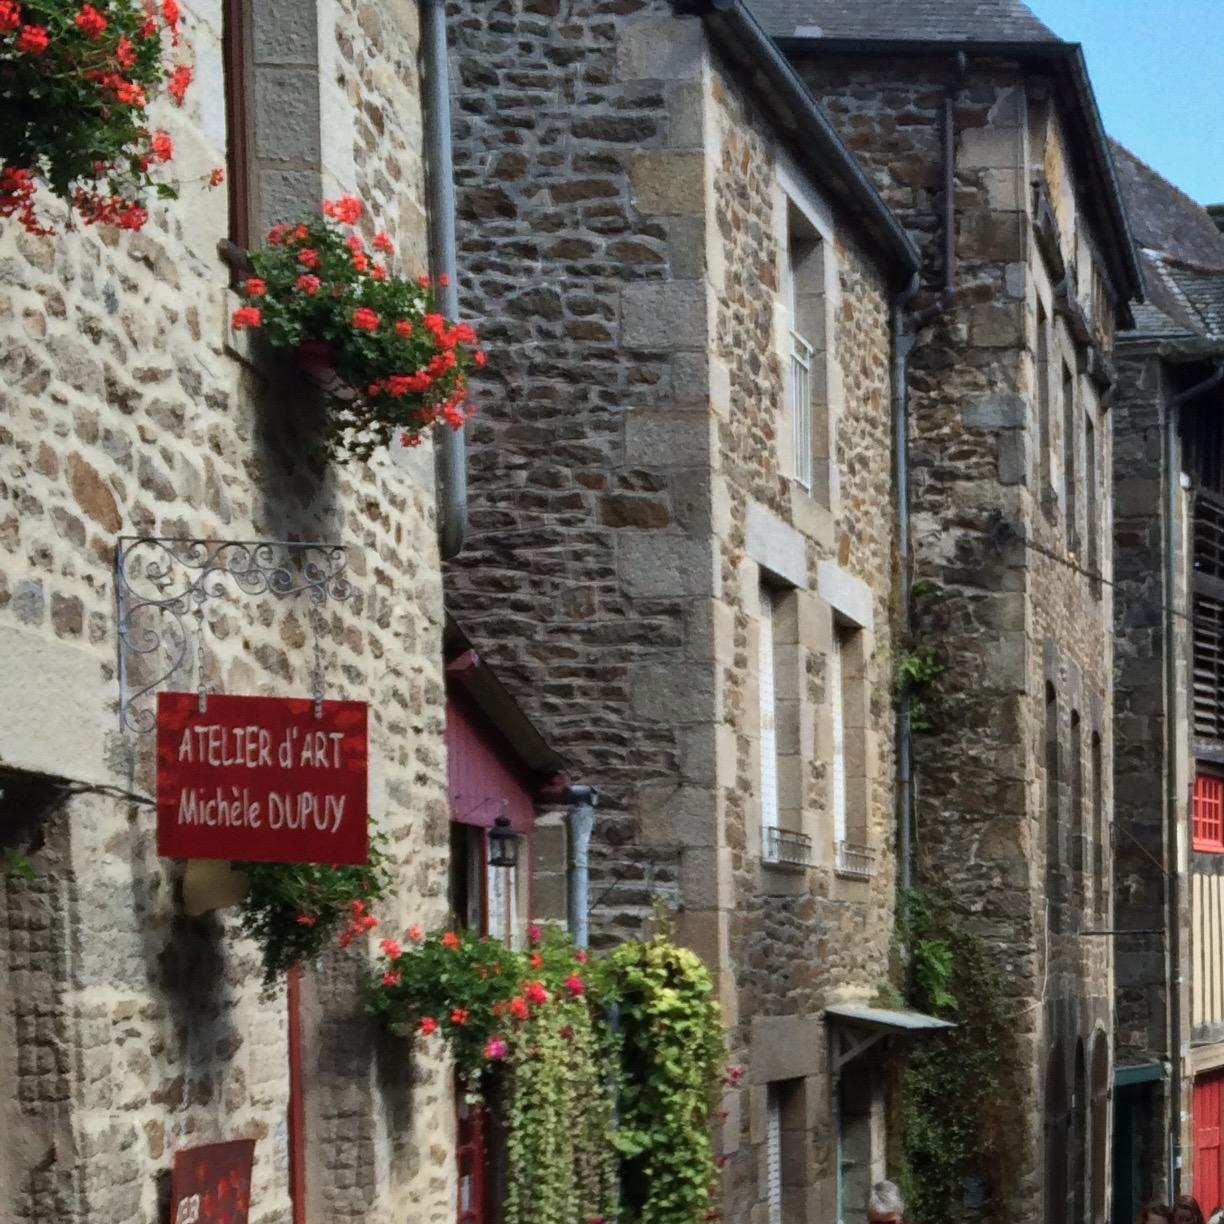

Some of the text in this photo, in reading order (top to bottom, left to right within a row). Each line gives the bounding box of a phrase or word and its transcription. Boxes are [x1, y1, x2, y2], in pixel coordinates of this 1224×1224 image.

[178, 725, 345, 769] ATELIER d'ART
[178, 786, 347, 833] Michèle DUPUY
